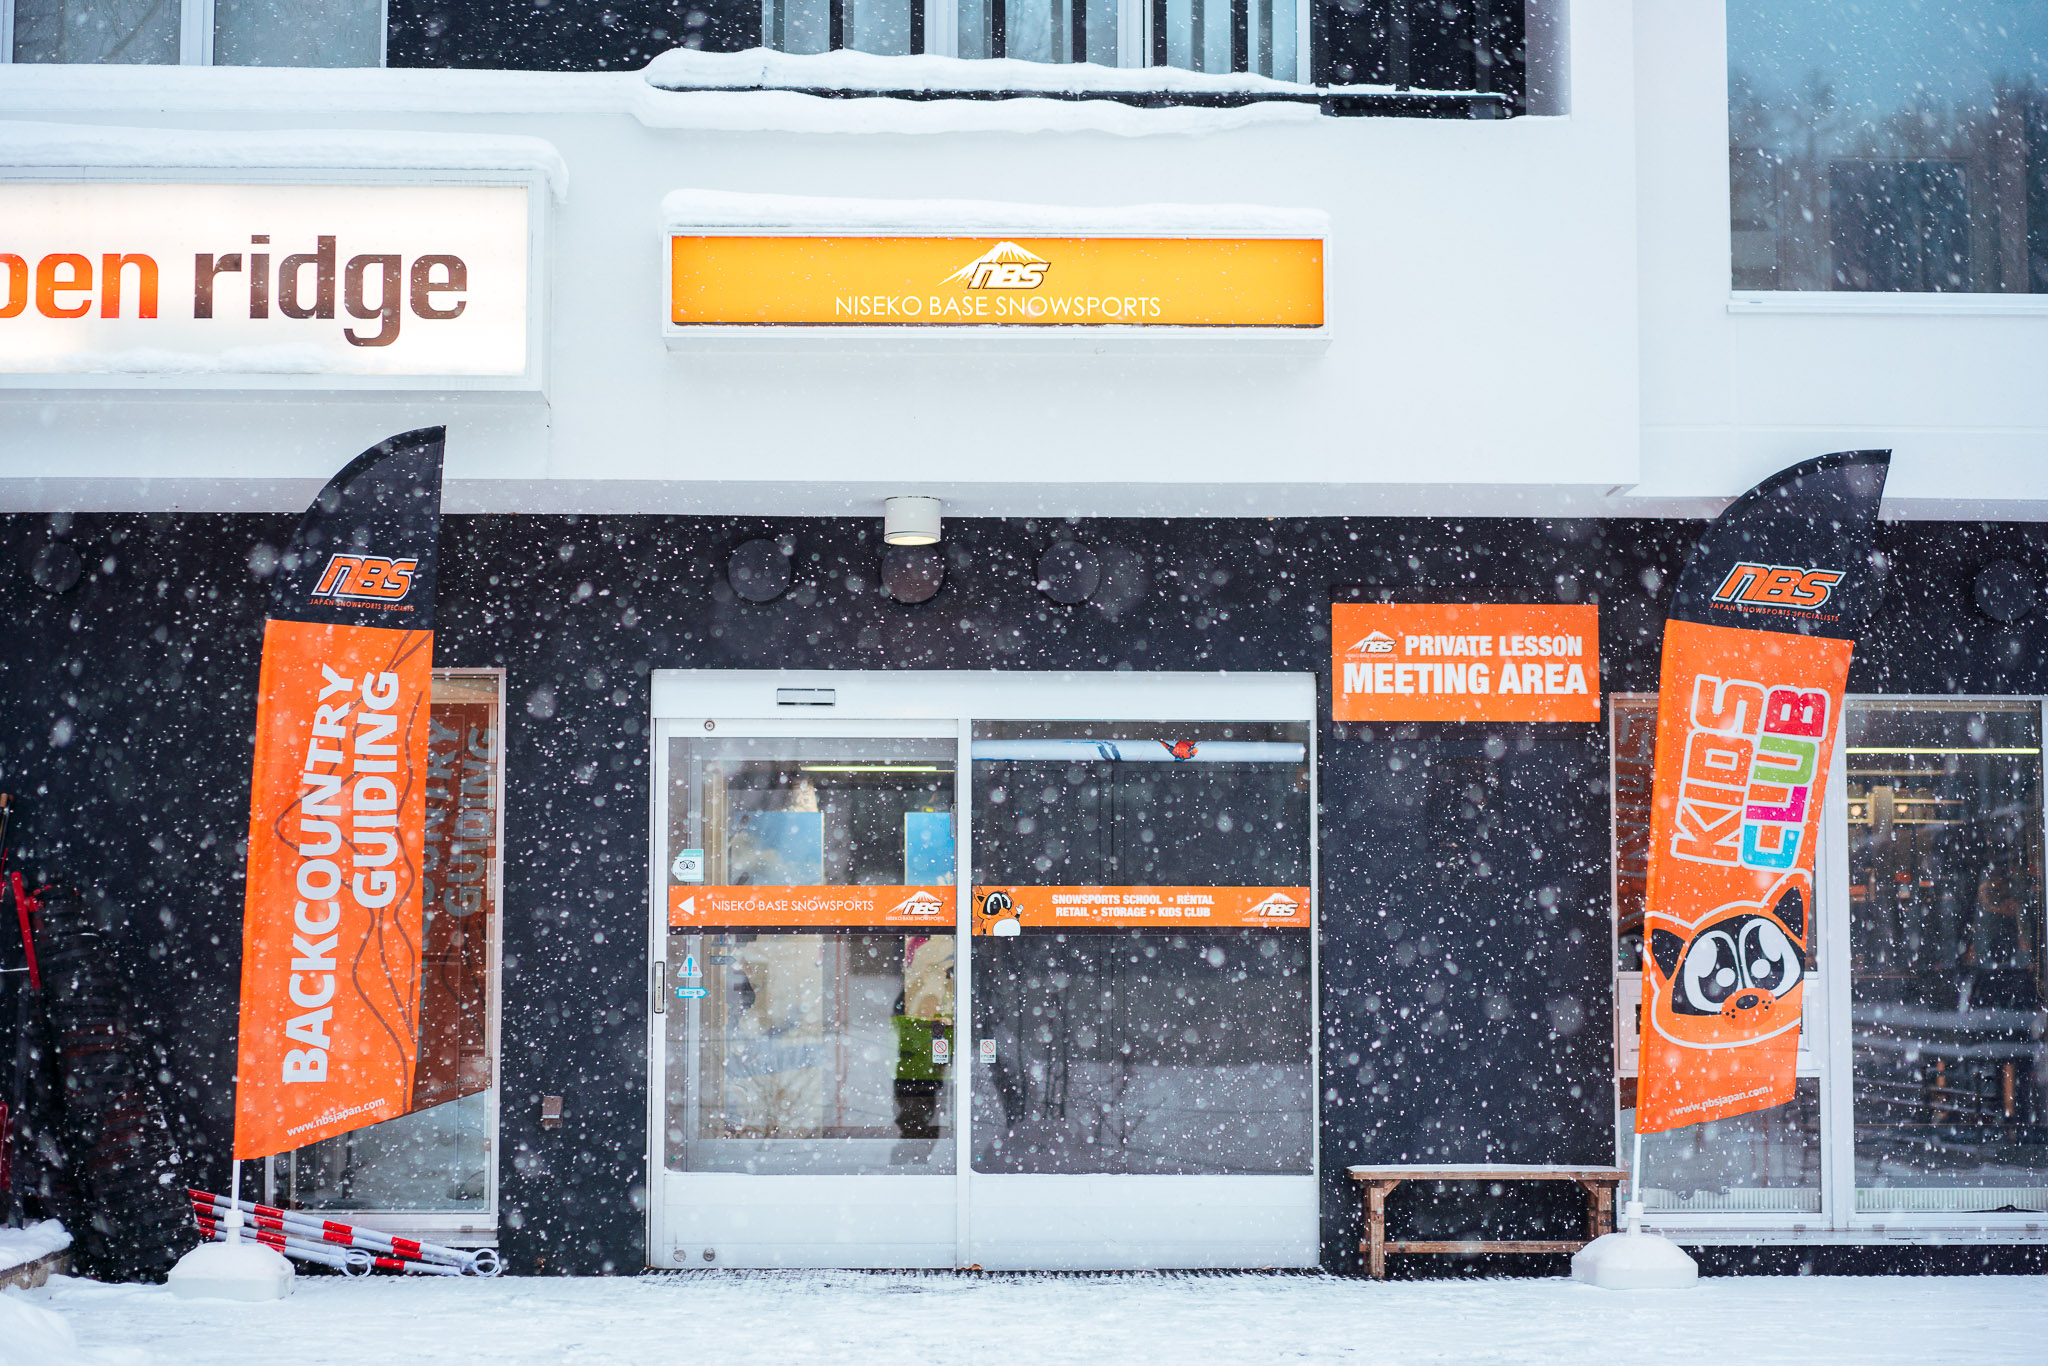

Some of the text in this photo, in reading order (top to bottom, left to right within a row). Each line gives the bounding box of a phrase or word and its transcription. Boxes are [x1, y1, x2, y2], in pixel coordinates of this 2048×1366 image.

[193, 235, 468, 347] ridge
[835, 295, 1161, 317] NISEKO BASE SNOWSPORTS
[309, 598, 334, 606] JAPAN
[1709, 602, 1839, 622] JAPAN SNOWSPORTS SPECIALISTS
[1405, 635, 1582, 657] PRIVATE LESSON
[1343, 663, 1589, 694] MEETING AREA
[1670, 673, 1769, 867] KIDS
[1740, 684, 1830, 873] CLUB
[352, 670, 400, 909] GUIDING
[282, 664, 355, 1084] BACKCOUNTRY
[712, 900, 874, 912] NISEKO BASE SNOWSPORTS
[1051, 894, 1215, 905] SNOWSPORTS SCHOOL RENTAL
[1055, 907, 1211, 917] RETAIL STORAGE KIDS CLUB
[1674, 1086, 1769, 1115] www.nbsjapan.com
[286, 1098, 386, 1137] www.nbsjapan.com
